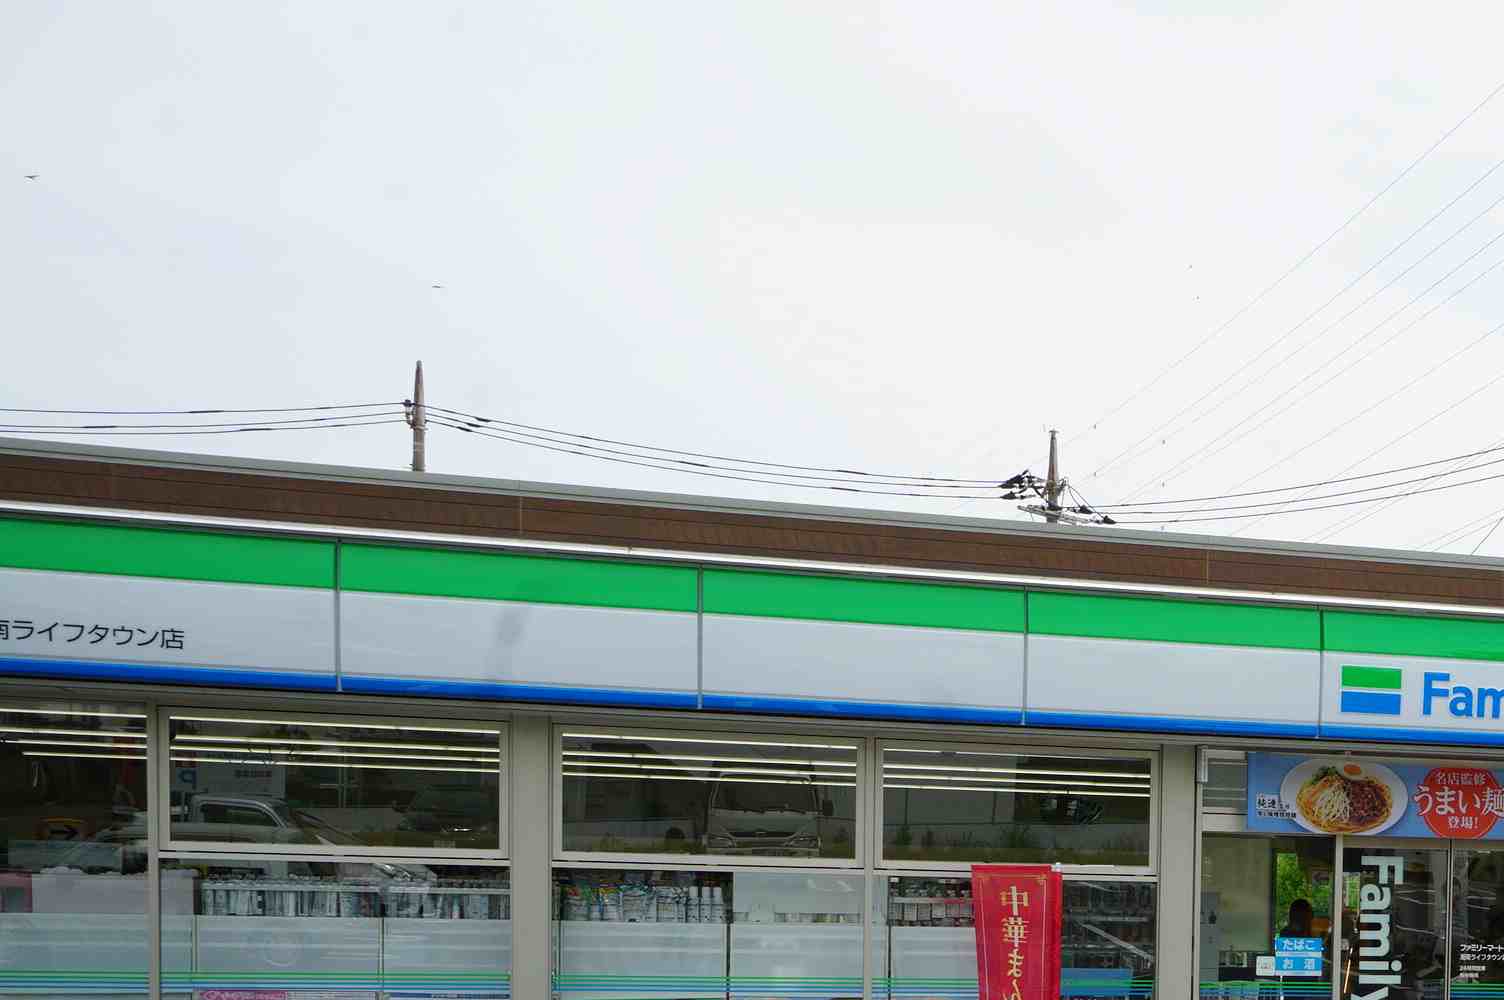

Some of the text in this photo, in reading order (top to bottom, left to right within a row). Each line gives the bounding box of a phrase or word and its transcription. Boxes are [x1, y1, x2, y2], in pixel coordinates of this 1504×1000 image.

[1283, 938, 1315, 951] たばこ
[1460, 943, 1504, 953] ファミリーマート
